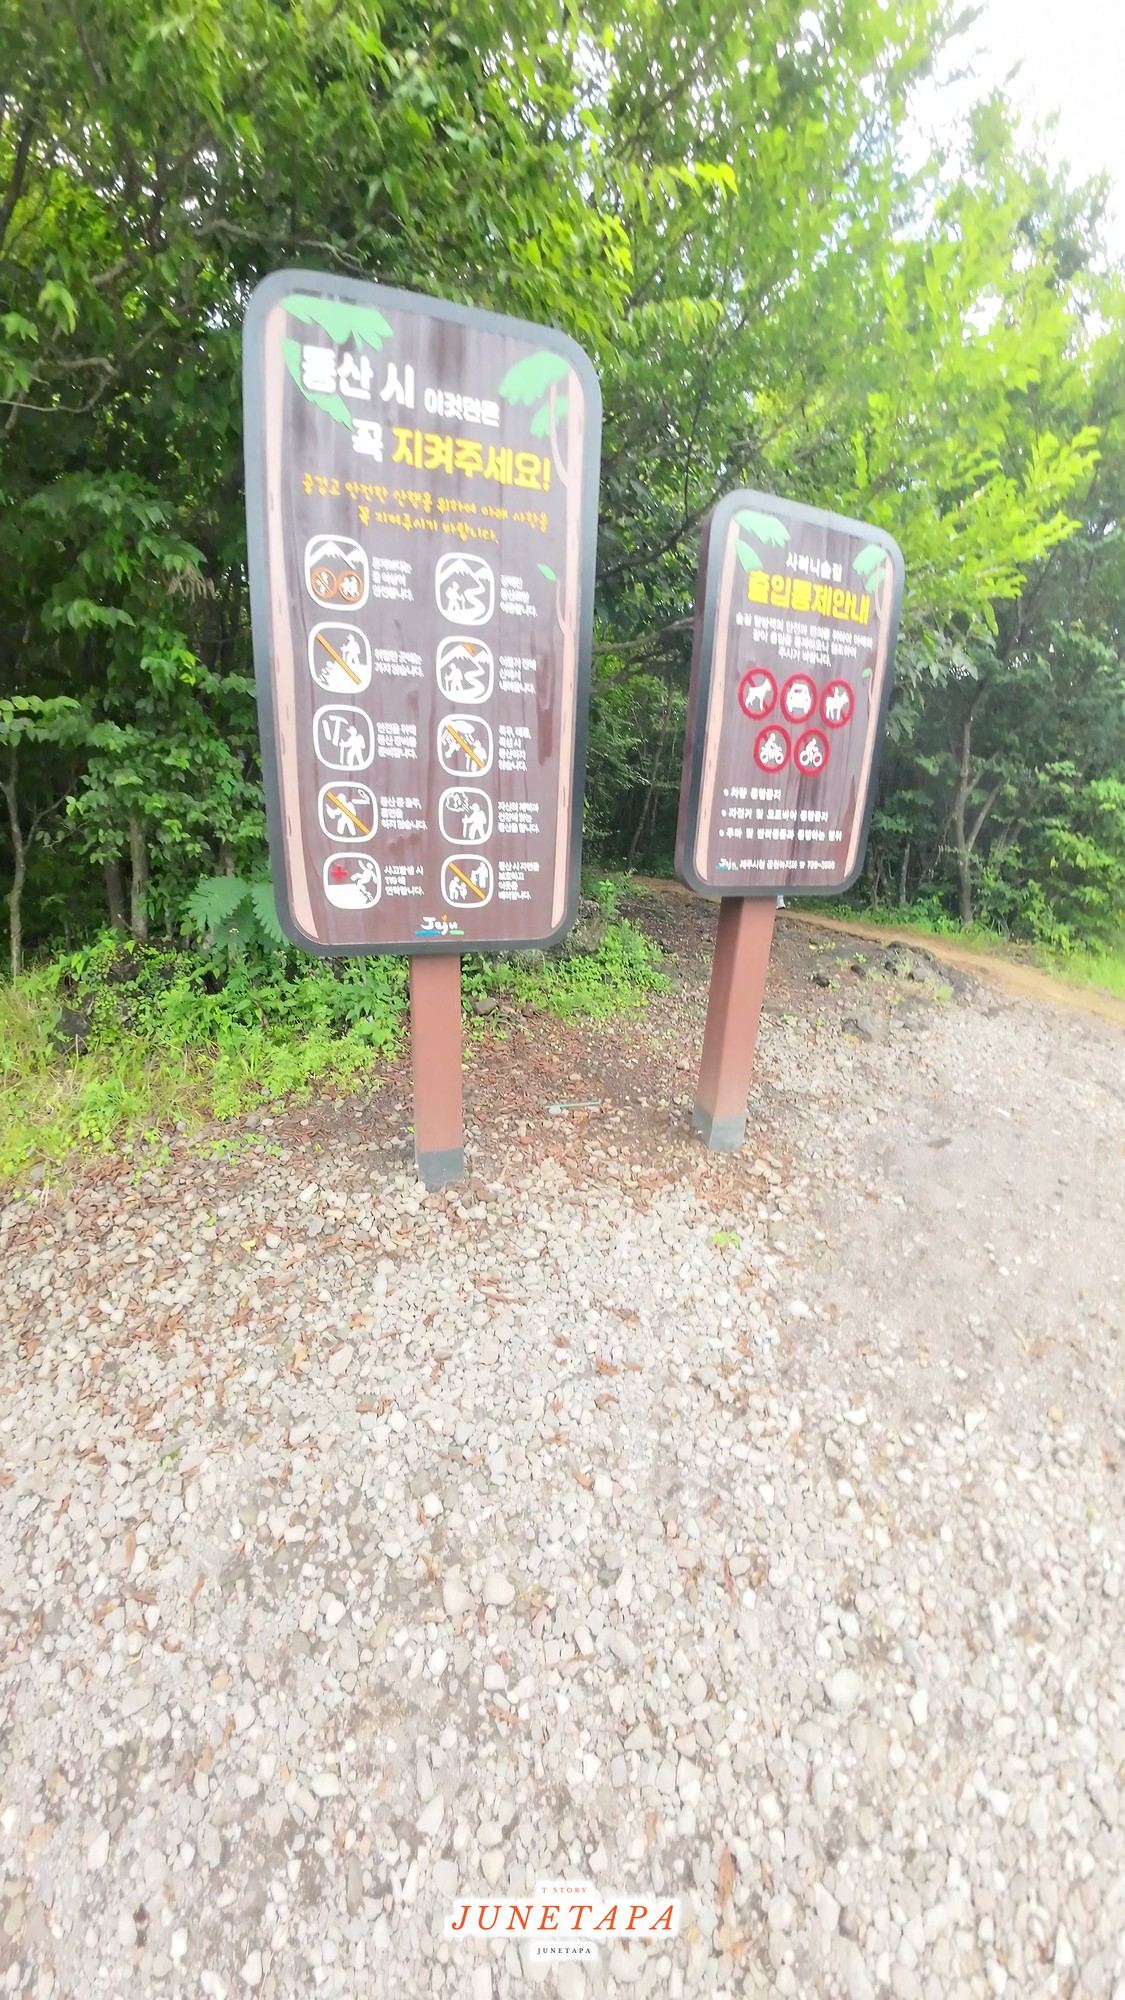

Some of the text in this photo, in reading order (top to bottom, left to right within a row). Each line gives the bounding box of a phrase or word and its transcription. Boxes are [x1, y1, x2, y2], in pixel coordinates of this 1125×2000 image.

[302, 345, 500, 427] 등산 시 이것만은
[352, 418, 550, 492] 꼭 지켜주세요!
[747, 569, 870, 625] 출입통제안내
